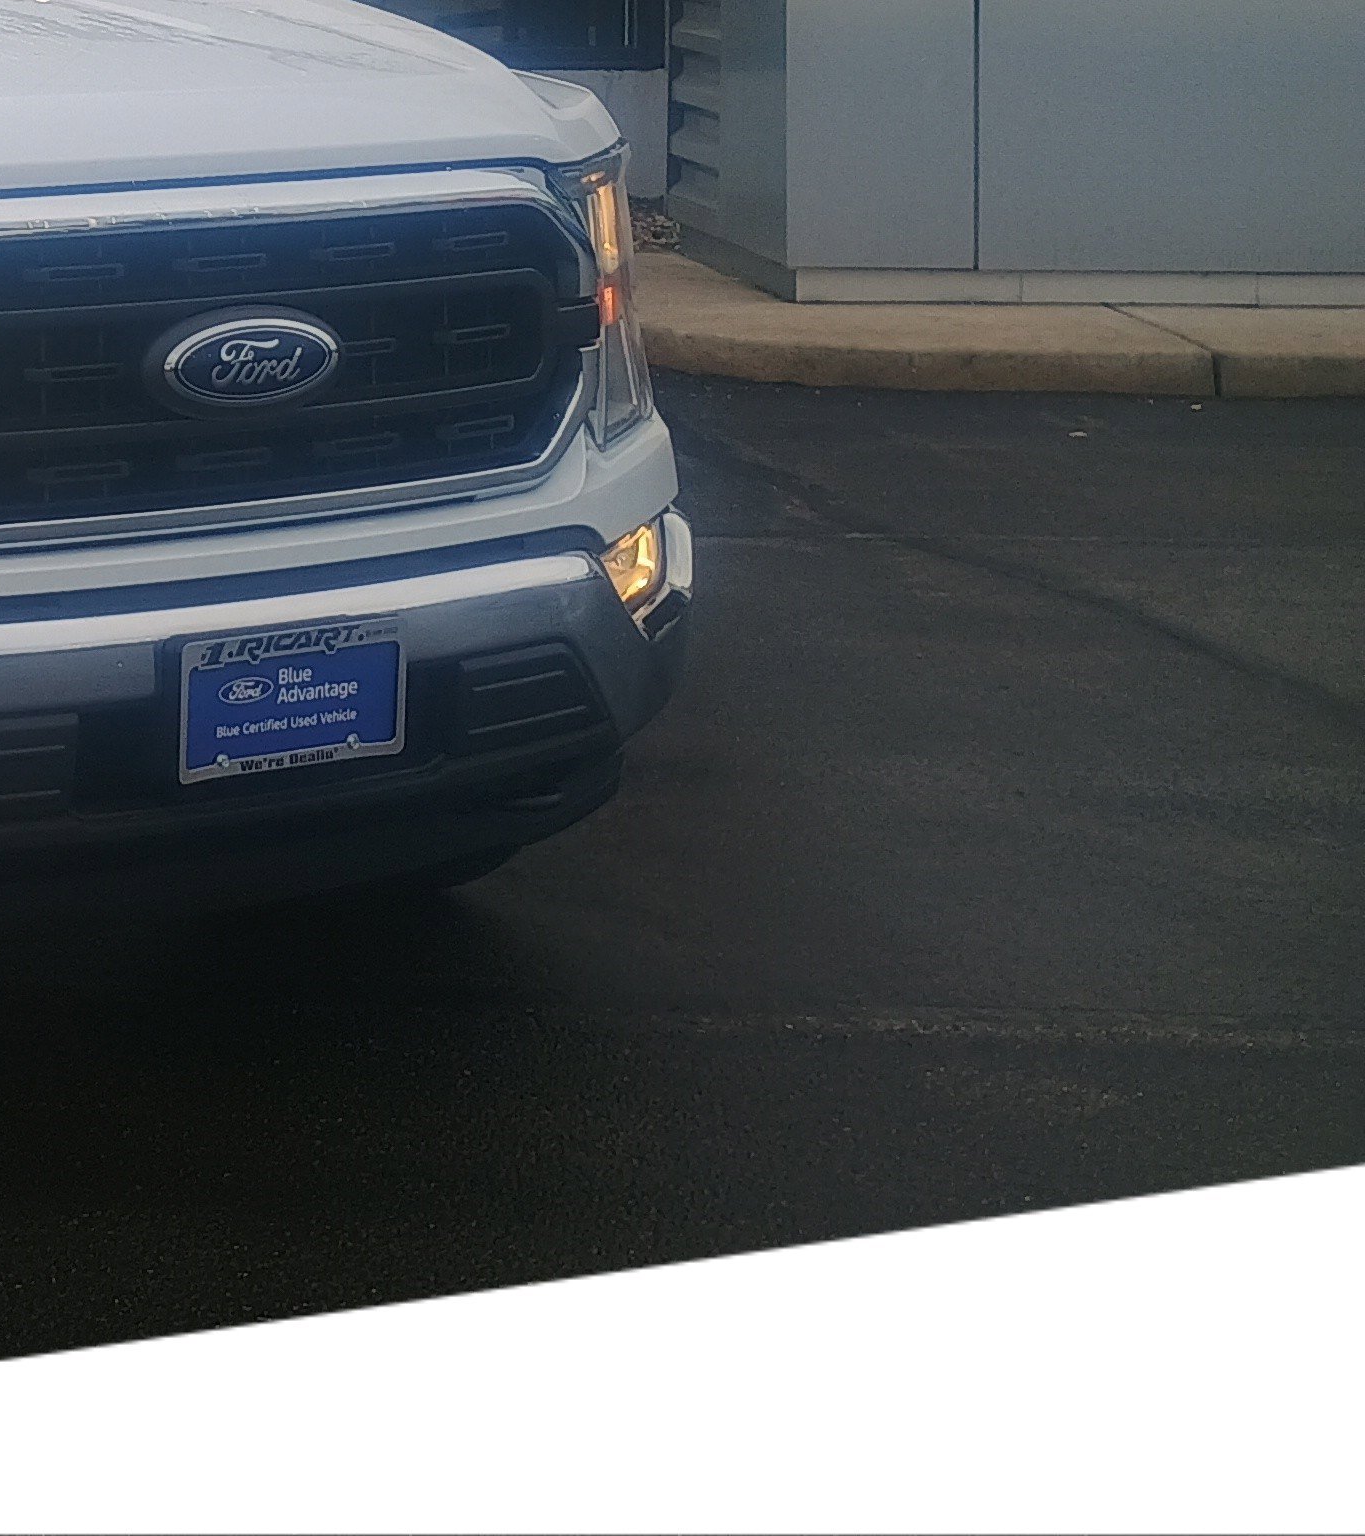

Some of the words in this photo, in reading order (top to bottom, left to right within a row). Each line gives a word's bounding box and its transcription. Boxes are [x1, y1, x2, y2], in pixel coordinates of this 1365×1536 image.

[211, 339, 303, 387] Ford
[278, 667, 312, 685] Blue
[228, 680, 262, 700] Ford
[277, 681, 358, 704] Advantage
[216, 725, 240, 738] Blue
[242, 718, 288, 735] Certified
[290, 714, 317, 728] Used
[319, 708, 357, 725] Vehicle
